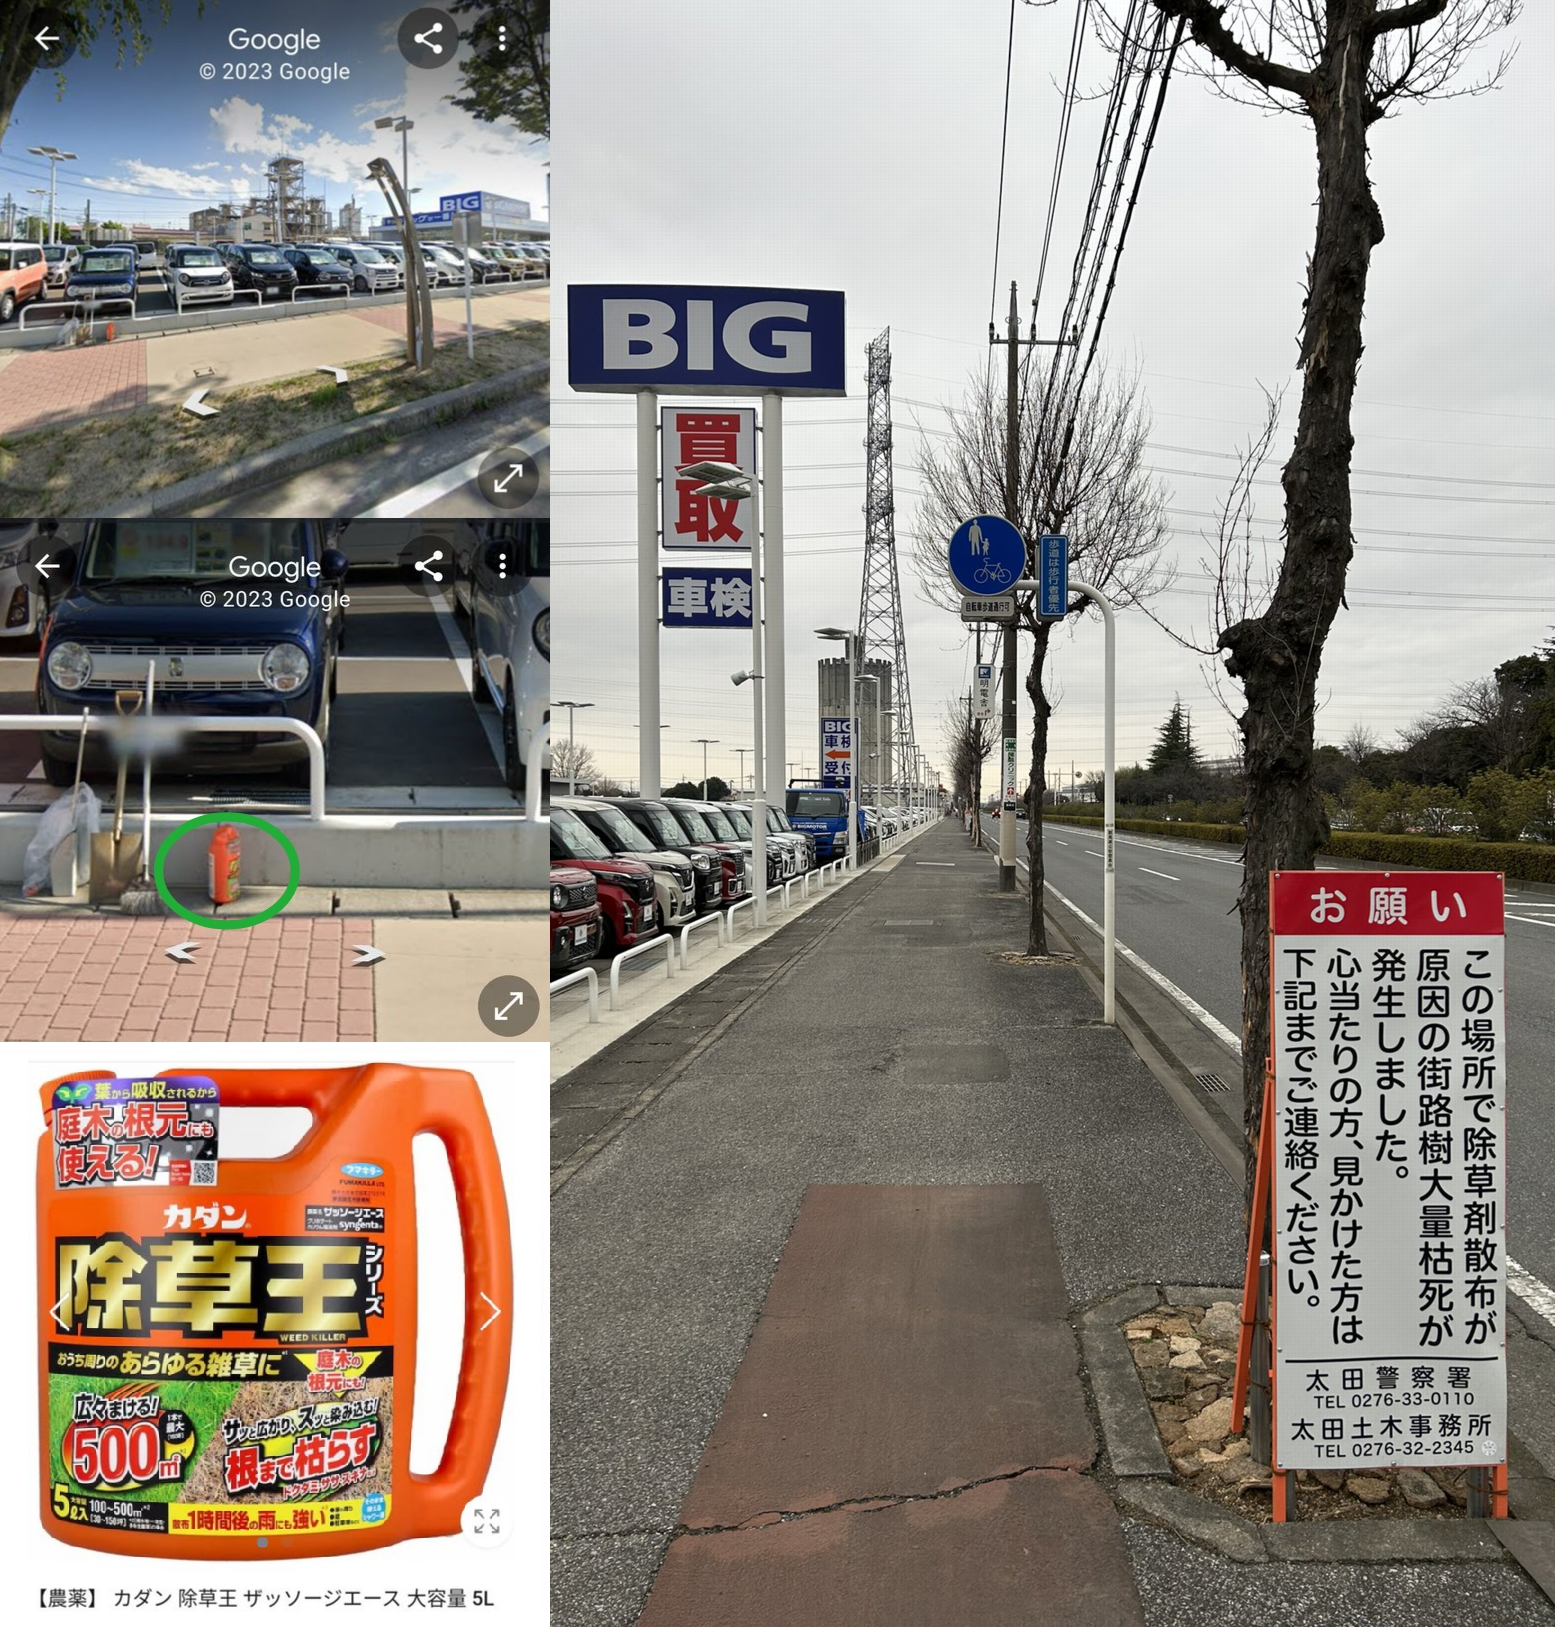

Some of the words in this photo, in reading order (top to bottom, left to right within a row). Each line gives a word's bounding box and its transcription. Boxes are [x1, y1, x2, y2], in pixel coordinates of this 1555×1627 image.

[442, 196, 479, 212] BIG
[602, 298, 812, 374] BIG
[674, 413, 744, 543] 買取
[1047, 539, 1061, 613] 歩道は歩行者優先
[667, 577, 753, 618] 車検
[1310, 886, 1467, 926] お願い
[1372, 948, 1409, 1180] 発生しました。
[94, 1081, 217, 1100] 葉から吸収されるから
[57, 1101, 214, 1143] 庭木の根元にも
[1283, 949, 1320, 1308] 下記までご連絡ください。
[58, 1144, 160, 1184] 使える!
[1326, 947, 1364, 1345] 心当たりの方、見かけた方は
[1416, 949, 1455, 1347] 原因の街路樹大量枯死が
[1461, 949, 1498, 1345] この場所で除草剤散布が
[346, 1165, 382, 1176] フマキラー
[162, 1200, 248, 1230] カダン
[339, 1218, 379, 1231] syngenta
[59, 1239, 361, 1332] 除草王
[364, 1244, 383, 1316] シリーズ
[280, 1333, 310, 1343] WEED
[311, 1332, 347, 1342] KILLER
[316, 1349, 361, 1370] 庭木の
[1306, 1365, 1472, 1393] 太田警察署
[1313, 1395, 1345, 1410] TEL
[1351, 1392, 1475, 1408] 0276-33-0110
[1291, 1413, 1492, 1441] 太田土木事務所
[225, 1422, 377, 1492] 根まで枯らす
[1313, 1444, 1346, 1459] TEL
[1352, 1440, 1475, 1458] 0276-32-2345
[172, 1508, 326, 1531] 散布1時間後の雨にも強い
